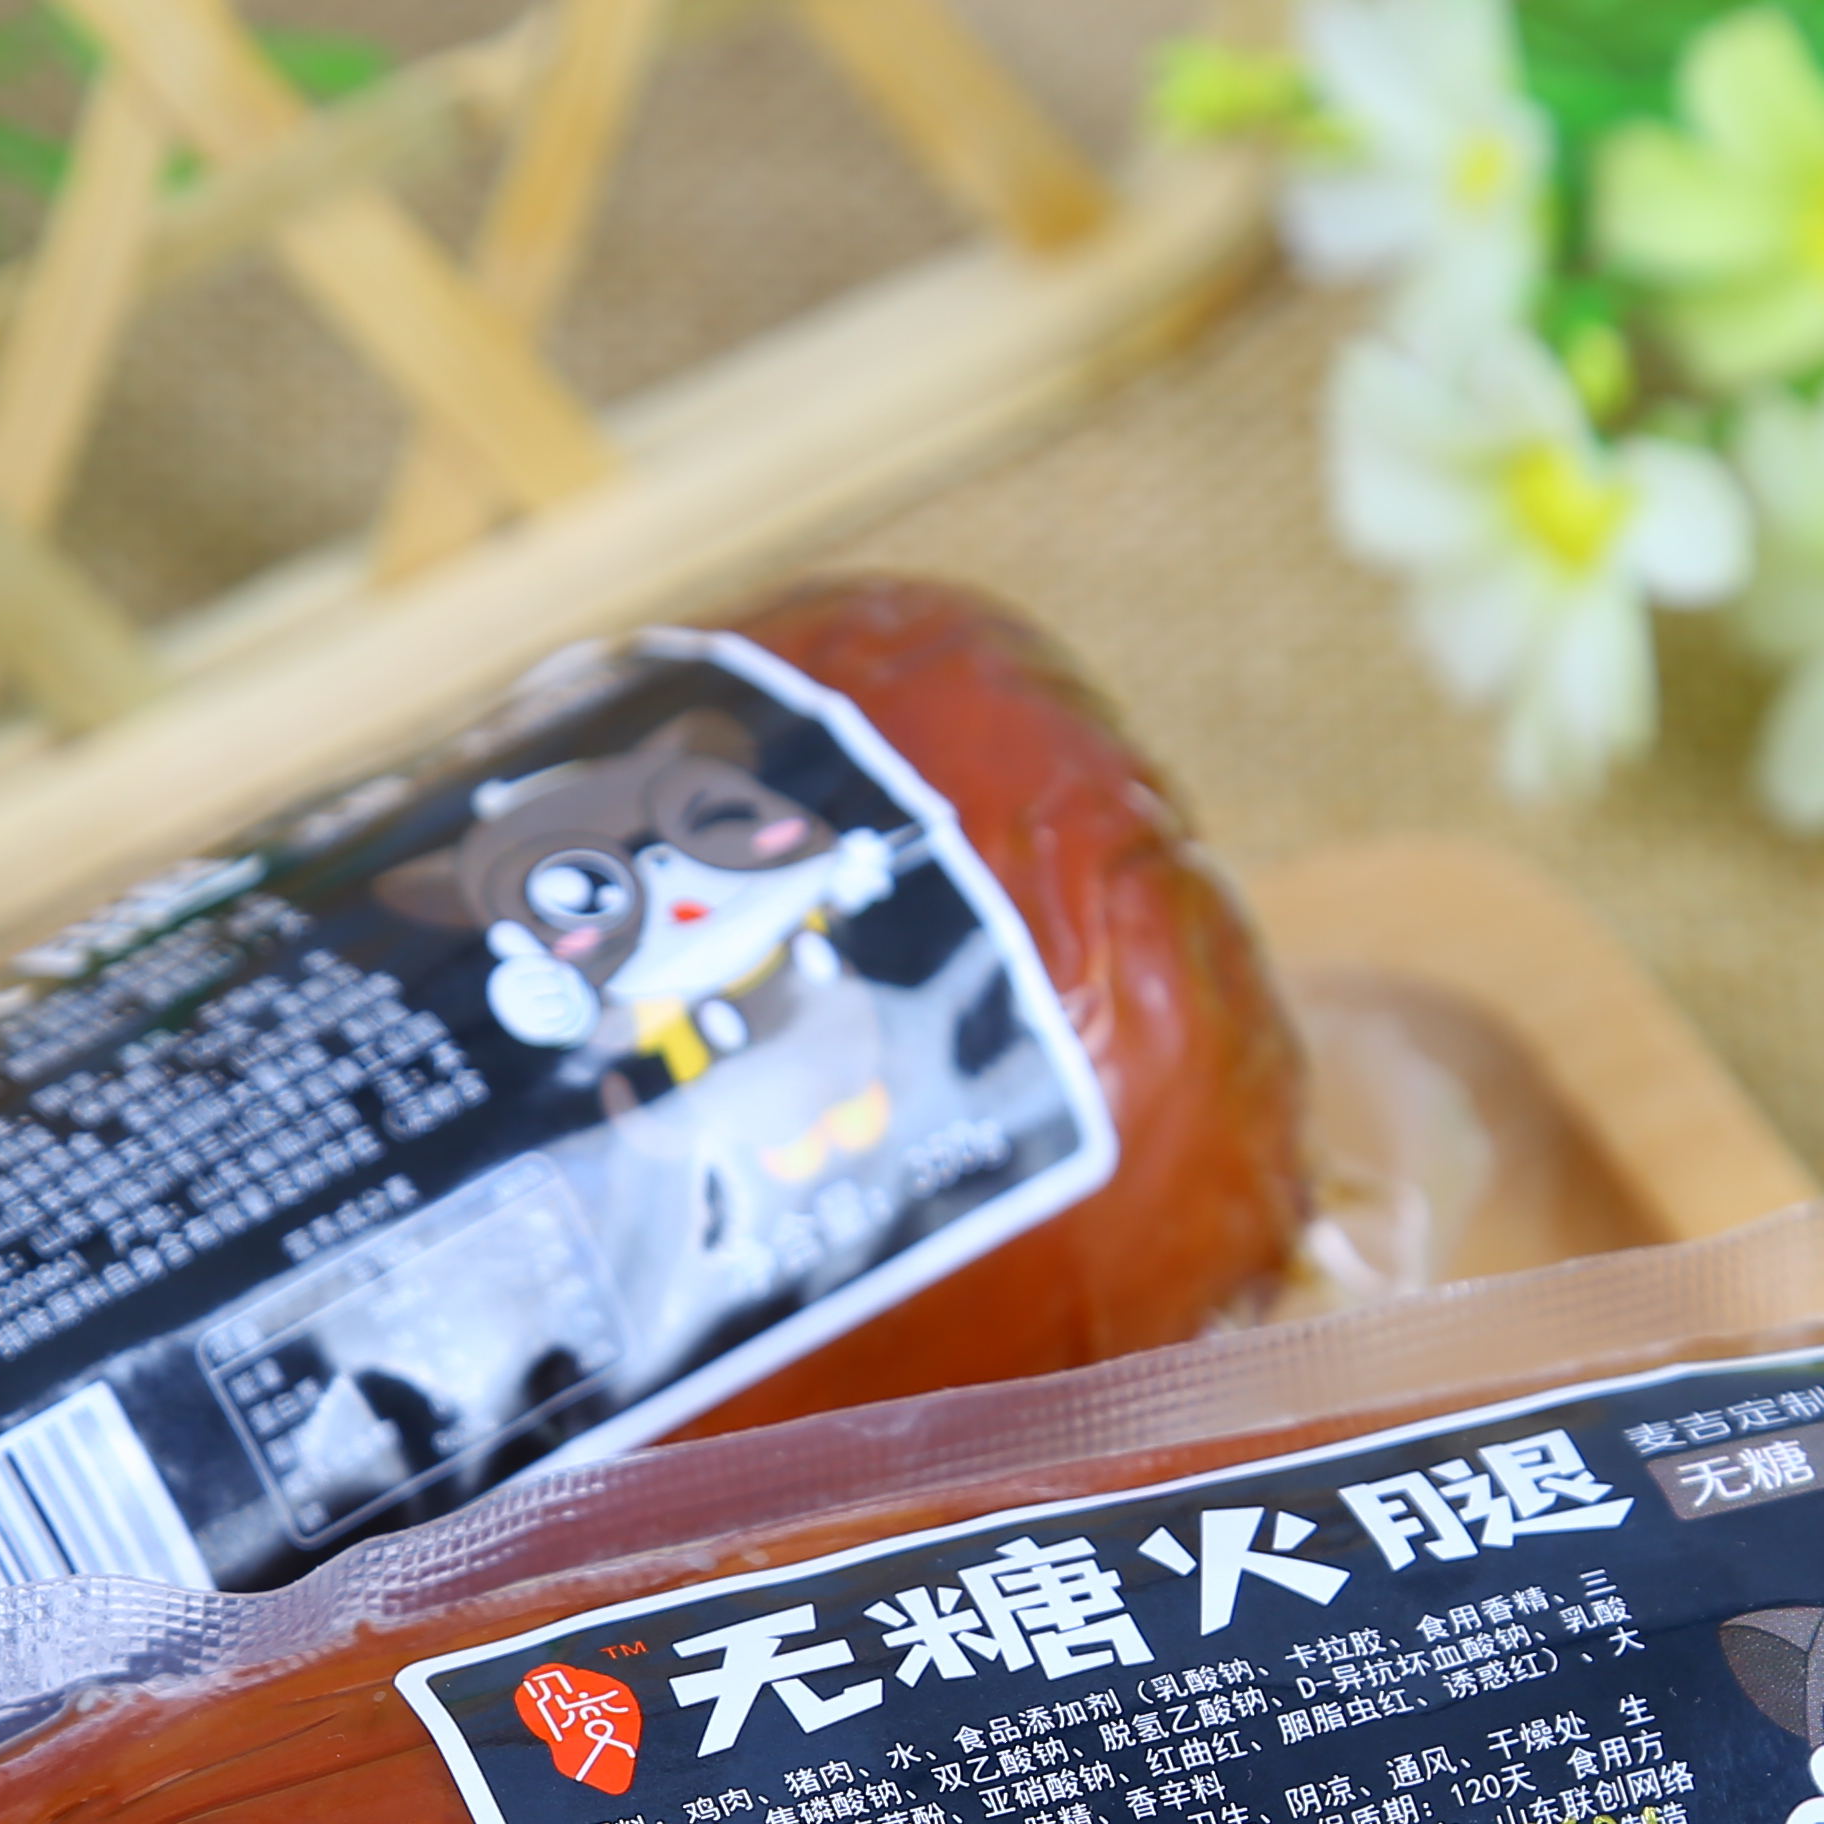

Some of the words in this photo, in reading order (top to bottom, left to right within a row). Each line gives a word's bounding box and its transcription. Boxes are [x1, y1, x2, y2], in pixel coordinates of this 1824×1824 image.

[669, 1428, 1634, 1758] 无糖火腿
[1566, 1729, 1663, 1780] 食用方
